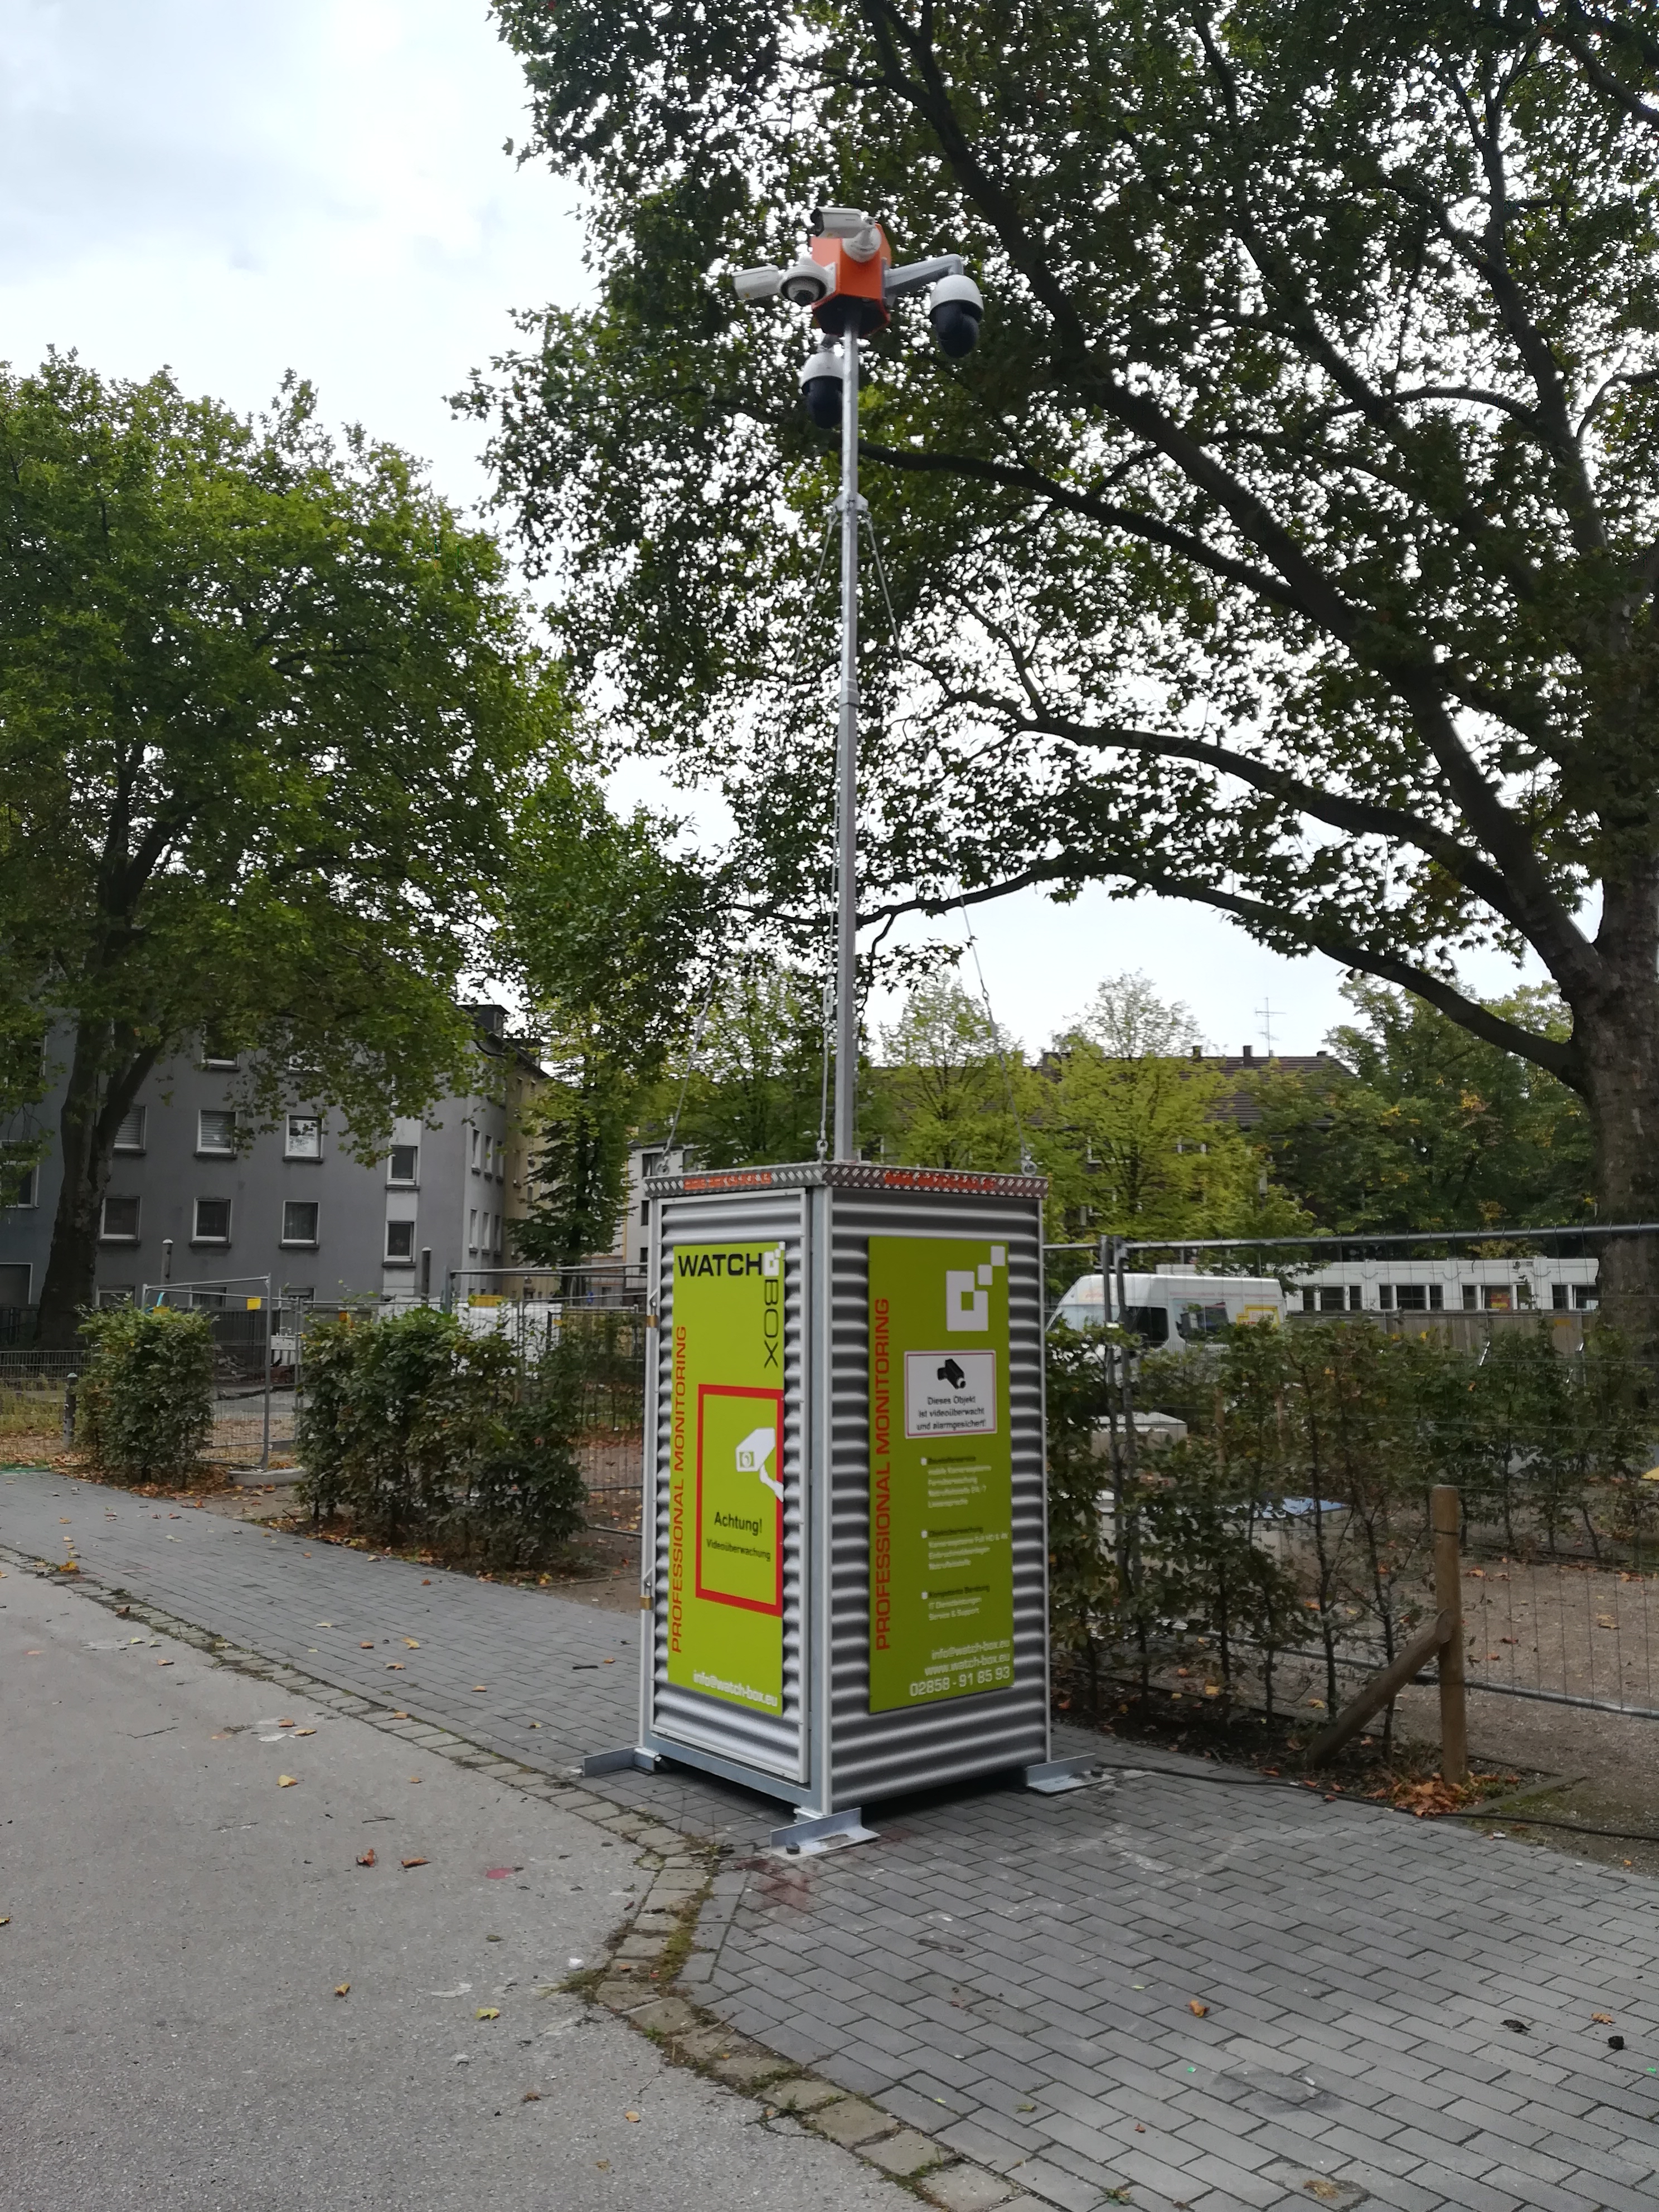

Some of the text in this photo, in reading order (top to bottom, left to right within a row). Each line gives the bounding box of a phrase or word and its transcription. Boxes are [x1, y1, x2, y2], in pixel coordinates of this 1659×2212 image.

[678, 1253, 763, 1277] WATCH
[764, 1279, 779, 1369] BOX
[927, 1395, 976, 1406] Dieses Objekt
[930, 1407, 984, 1418] videoüberwacht
[916, 1422, 931, 1431] und
[875, 1299, 890, 1650] PROFESSIONAL MONITORING
[672, 1326, 687, 1652] PROFESSIONAL MONITORING
[714, 1511, 762, 1536] Achtung!
[706, 1538, 771, 1562] Videoüberwachung
[932, 1640, 1011, 1661] info@watch-box.eu
[924, 1653, 1011, 1677] www.watch-box.eu
[693, 1669, 778, 1707] info@watch-box.eu
[909, 1677, 950, 1697] 02858
[958, 1673, 973, 1688] 91
[977, 1669, 993, 1684] 85
[995, 1666, 1011, 1681] 93
